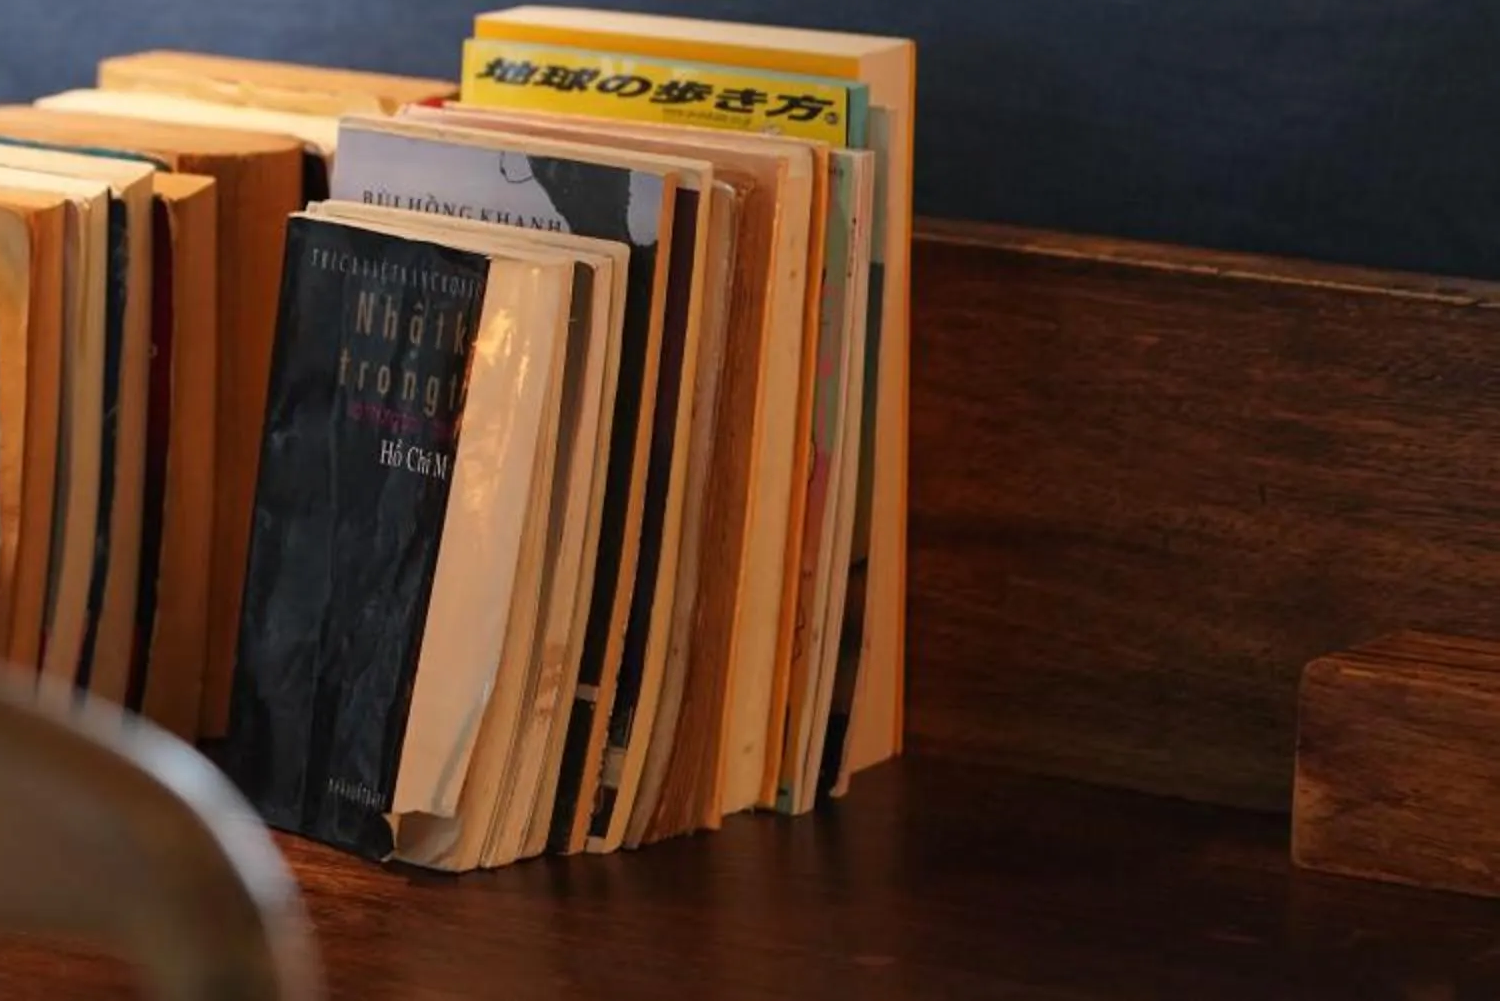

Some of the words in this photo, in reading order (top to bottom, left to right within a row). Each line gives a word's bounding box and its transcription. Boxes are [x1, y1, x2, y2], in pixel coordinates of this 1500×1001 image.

[477, 57, 834, 121] 地球の歩き方
